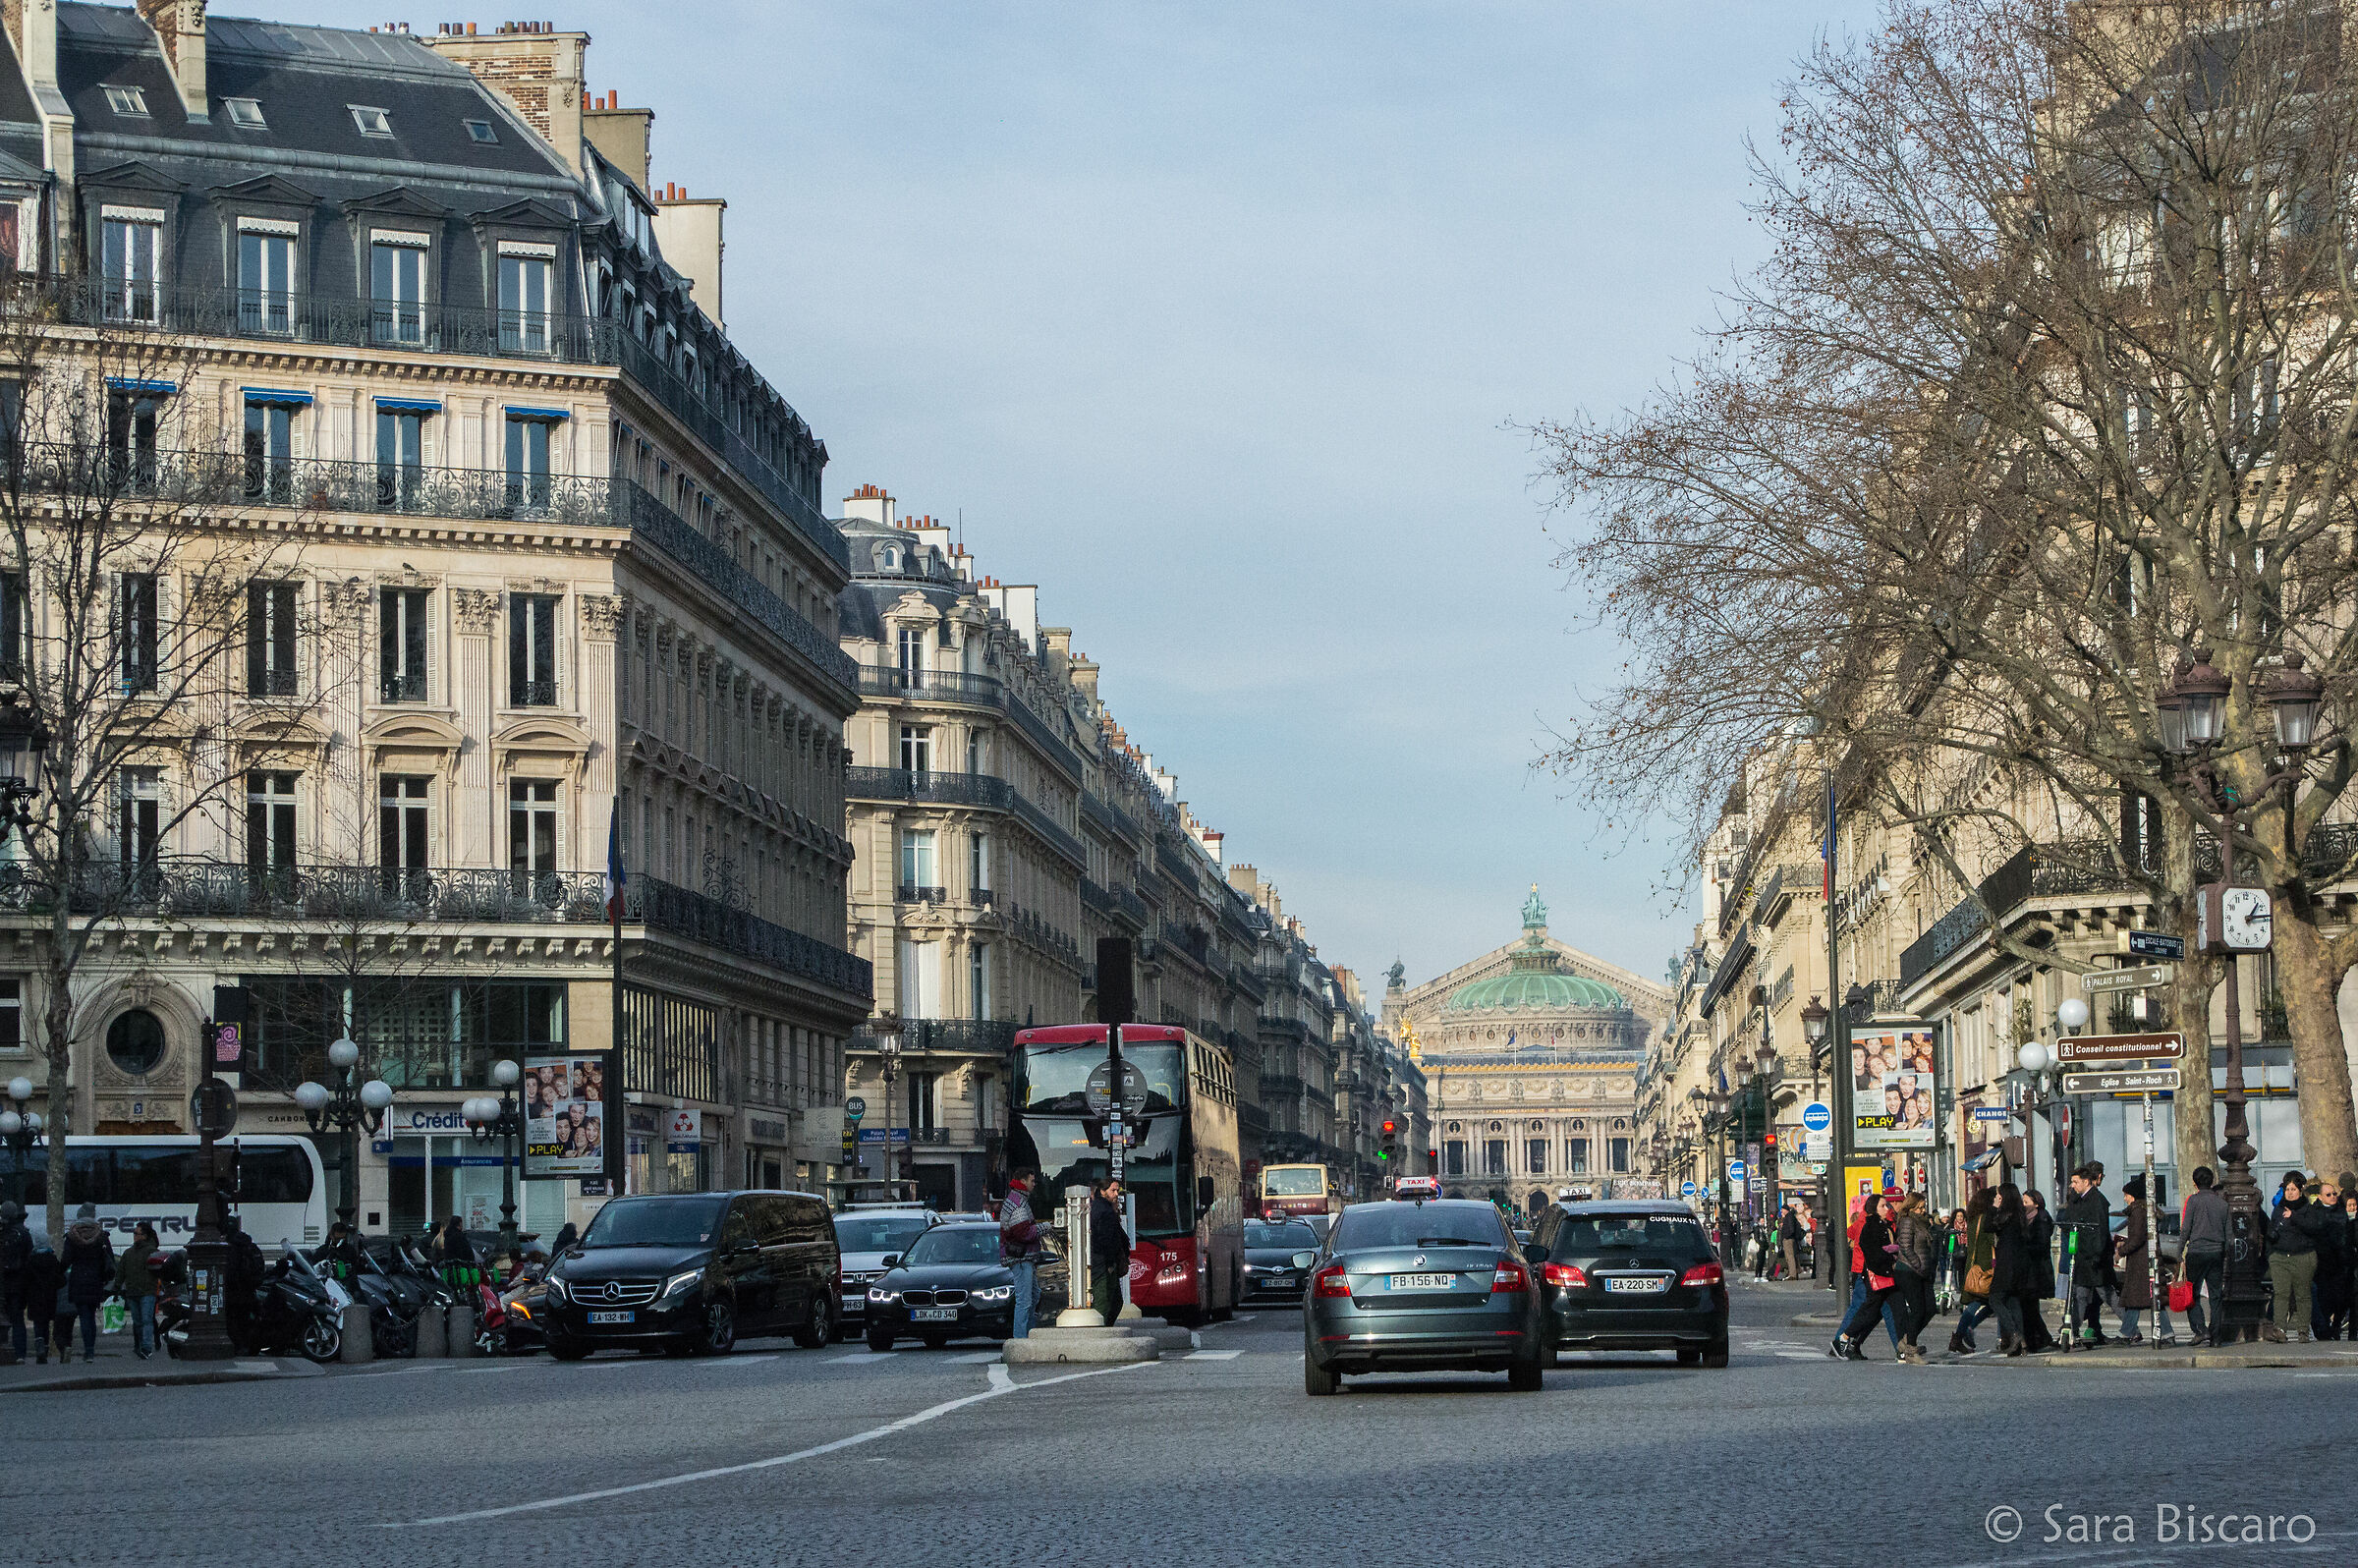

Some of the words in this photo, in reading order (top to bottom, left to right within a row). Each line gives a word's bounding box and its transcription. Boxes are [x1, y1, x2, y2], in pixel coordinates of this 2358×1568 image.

[2093, 977, 2112, 986] PALAIS
[2115, 975, 2134, 983] ROYAL
[2076, 1045, 2104, 1054] Conseil
[2105, 1042, 2162, 1052] constitutionnel
[2101, 1078, 2119, 1088] Eglise
[2125, 1076, 2162, 1085] Saint-Roch
[136, 1103, 141, 1112] 5
[848, 1101, 863, 1110] BUS
[413, 1111, 465, 1129] Crédit
[1866, 1117, 1894, 1127] PLAY
[536, 1145, 564, 1154] PLAY
[98, 1216, 196, 1234] PETRU
[1160, 1252, 1178, 1261] 175
[1612, 1280, 1657, 1290] EA-220-SM
[944, 1310, 957, 1318] 340
